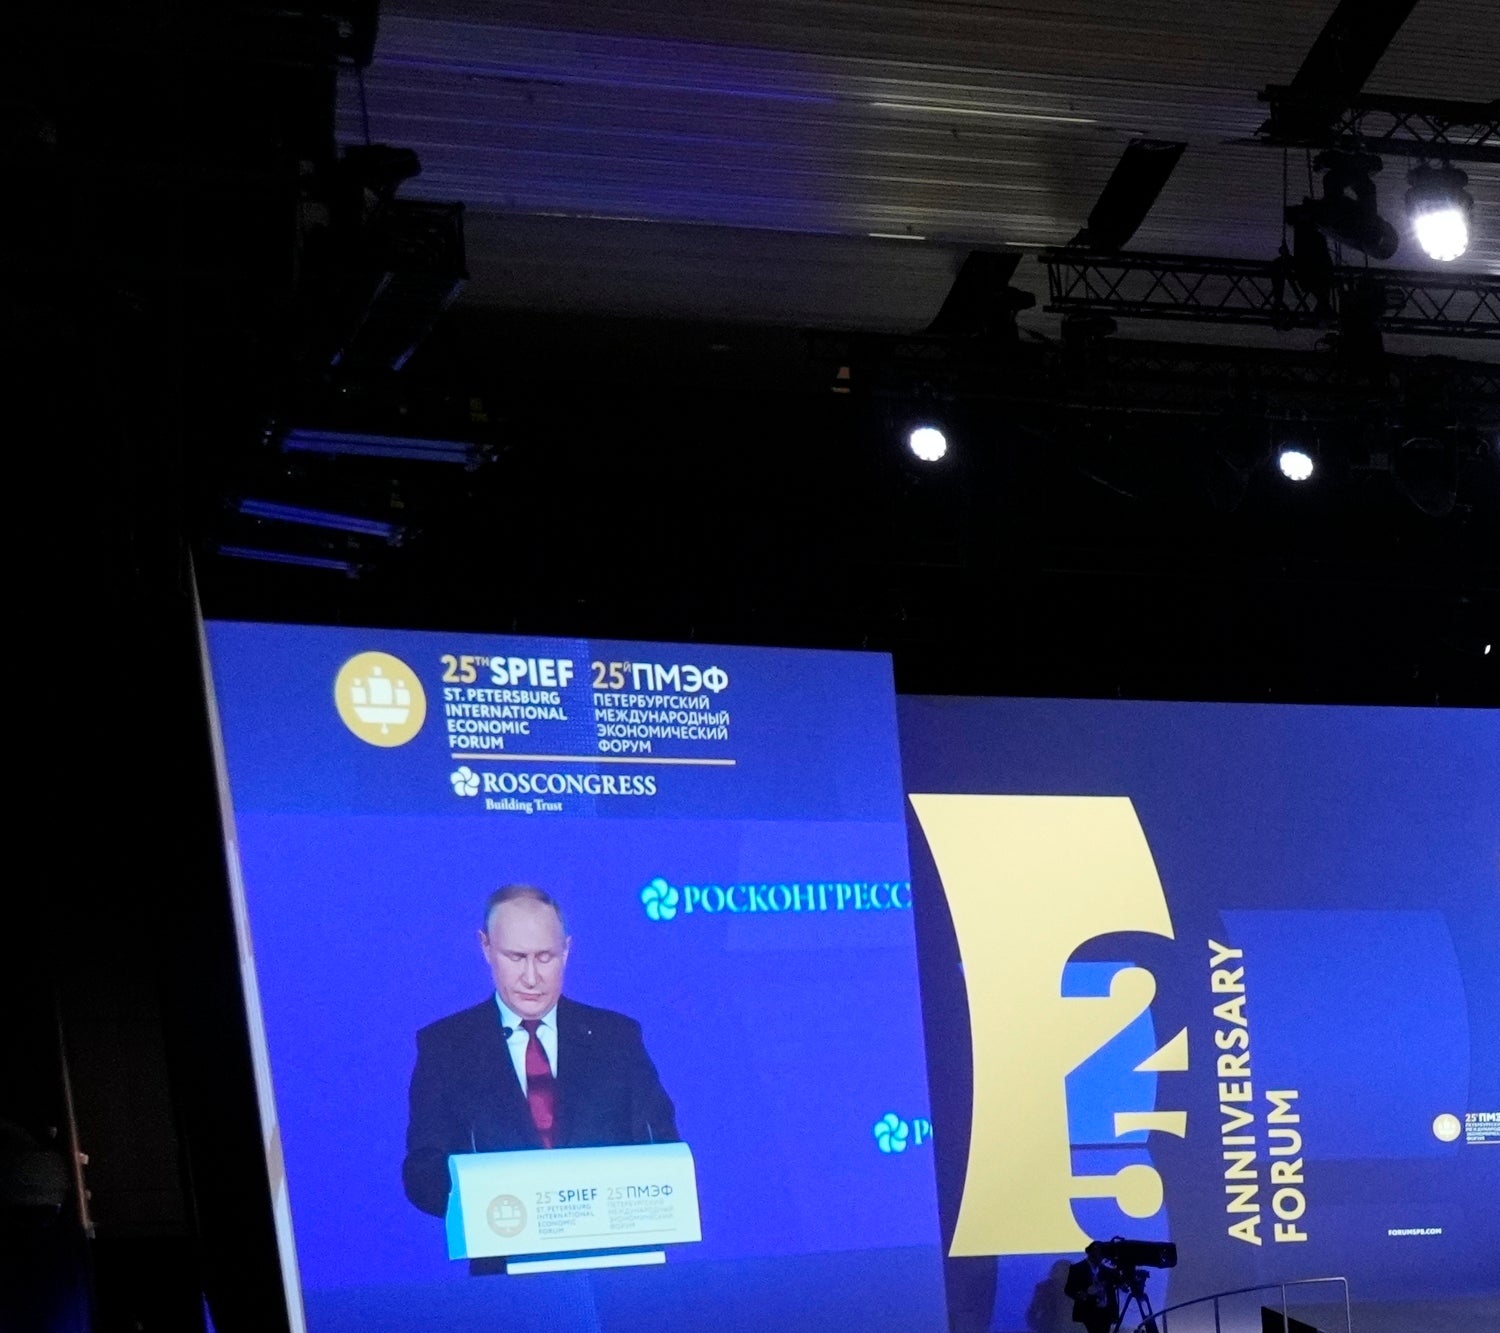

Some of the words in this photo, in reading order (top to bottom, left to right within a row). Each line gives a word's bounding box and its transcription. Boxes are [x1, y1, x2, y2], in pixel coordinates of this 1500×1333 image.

[490, 656, 573, 688] SPIEF
[631, 662, 728, 694] ПМЭФ
[444, 687, 464, 701] ST.
[467, 688, 561, 705] PETERSBURG
[594, 692, 710, 710] ПЕТЕРБУРГСКИЙ
[445, 703, 567, 721] INTERNATIONAL
[595, 708, 730, 726] МЕЖДУНАРОДНЫЙ
[448, 719, 530, 735] ECONOMIC
[597, 723, 729, 741] ЭКОНОМИЧЕСКИЙ
[449, 734, 504, 749] FORUM
[598, 739, 652, 754] ФОРУМ
[483, 772, 657, 797] ROSCONGRESS
[485, 798, 533, 814] Building
[534, 800, 563, 813] Trust
[684, 881, 912, 914] РОСКОНГРЕСС
[1208, 938, 1263, 1247] ANNIVERSARY
[1266, 1089, 1307, 1243] FORUM
[558, 1188, 598, 1202] SPIEF
[626, 1184, 673, 1198] ПМЭФ
